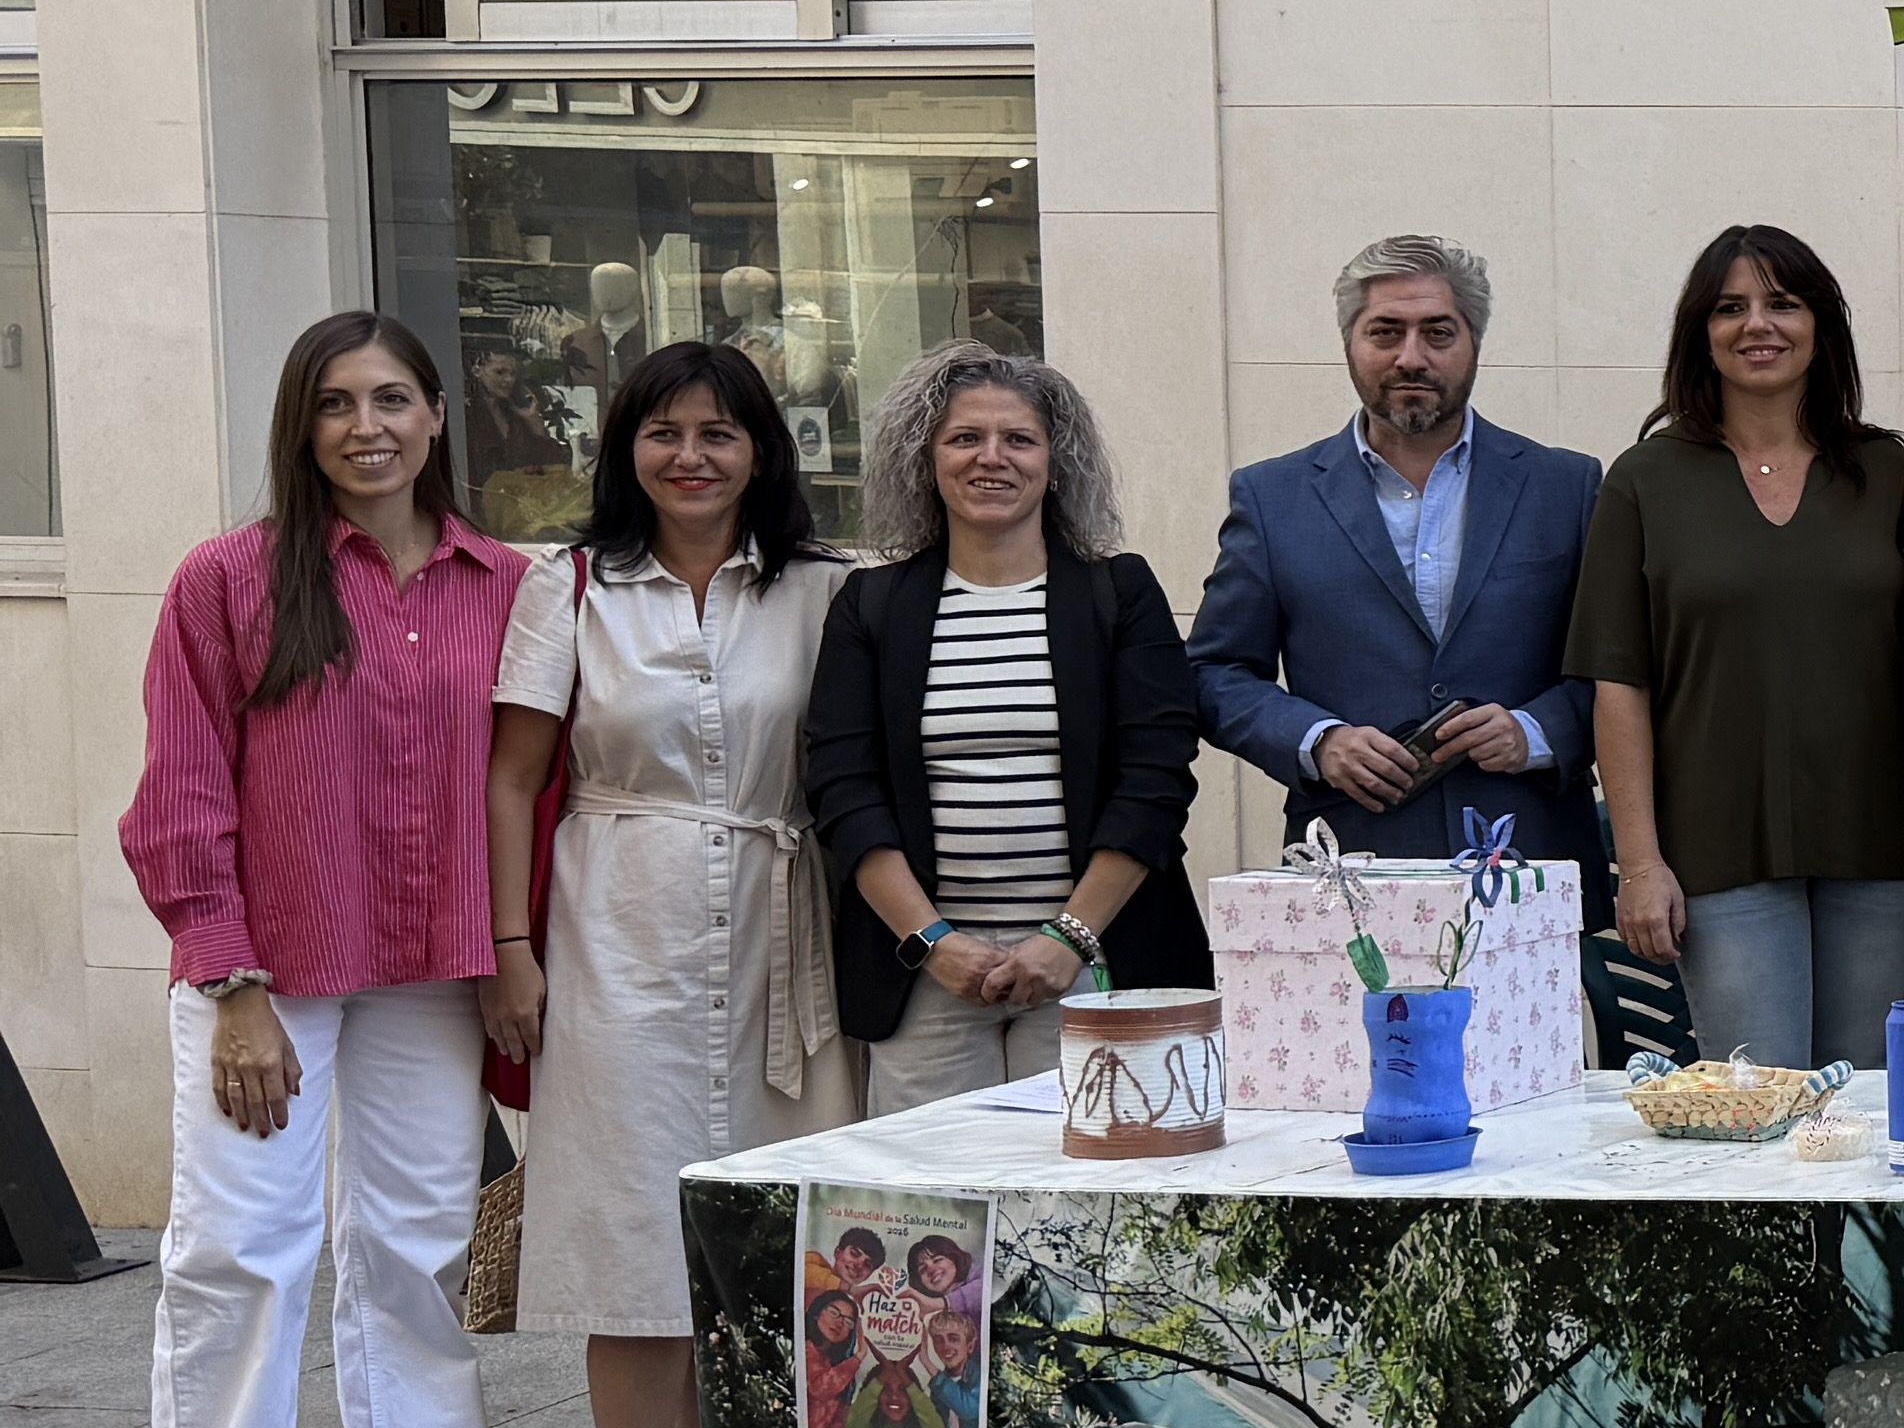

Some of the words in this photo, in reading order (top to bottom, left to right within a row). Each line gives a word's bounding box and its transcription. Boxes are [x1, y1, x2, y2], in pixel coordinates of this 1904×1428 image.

[842, 1209, 883, 1222] Mundial
[903, 1214, 930, 1227] Salud
[933, 1217, 968, 1230] Mental
[869, 1293, 896, 1313] Haz
[867, 1311, 921, 1334] match
